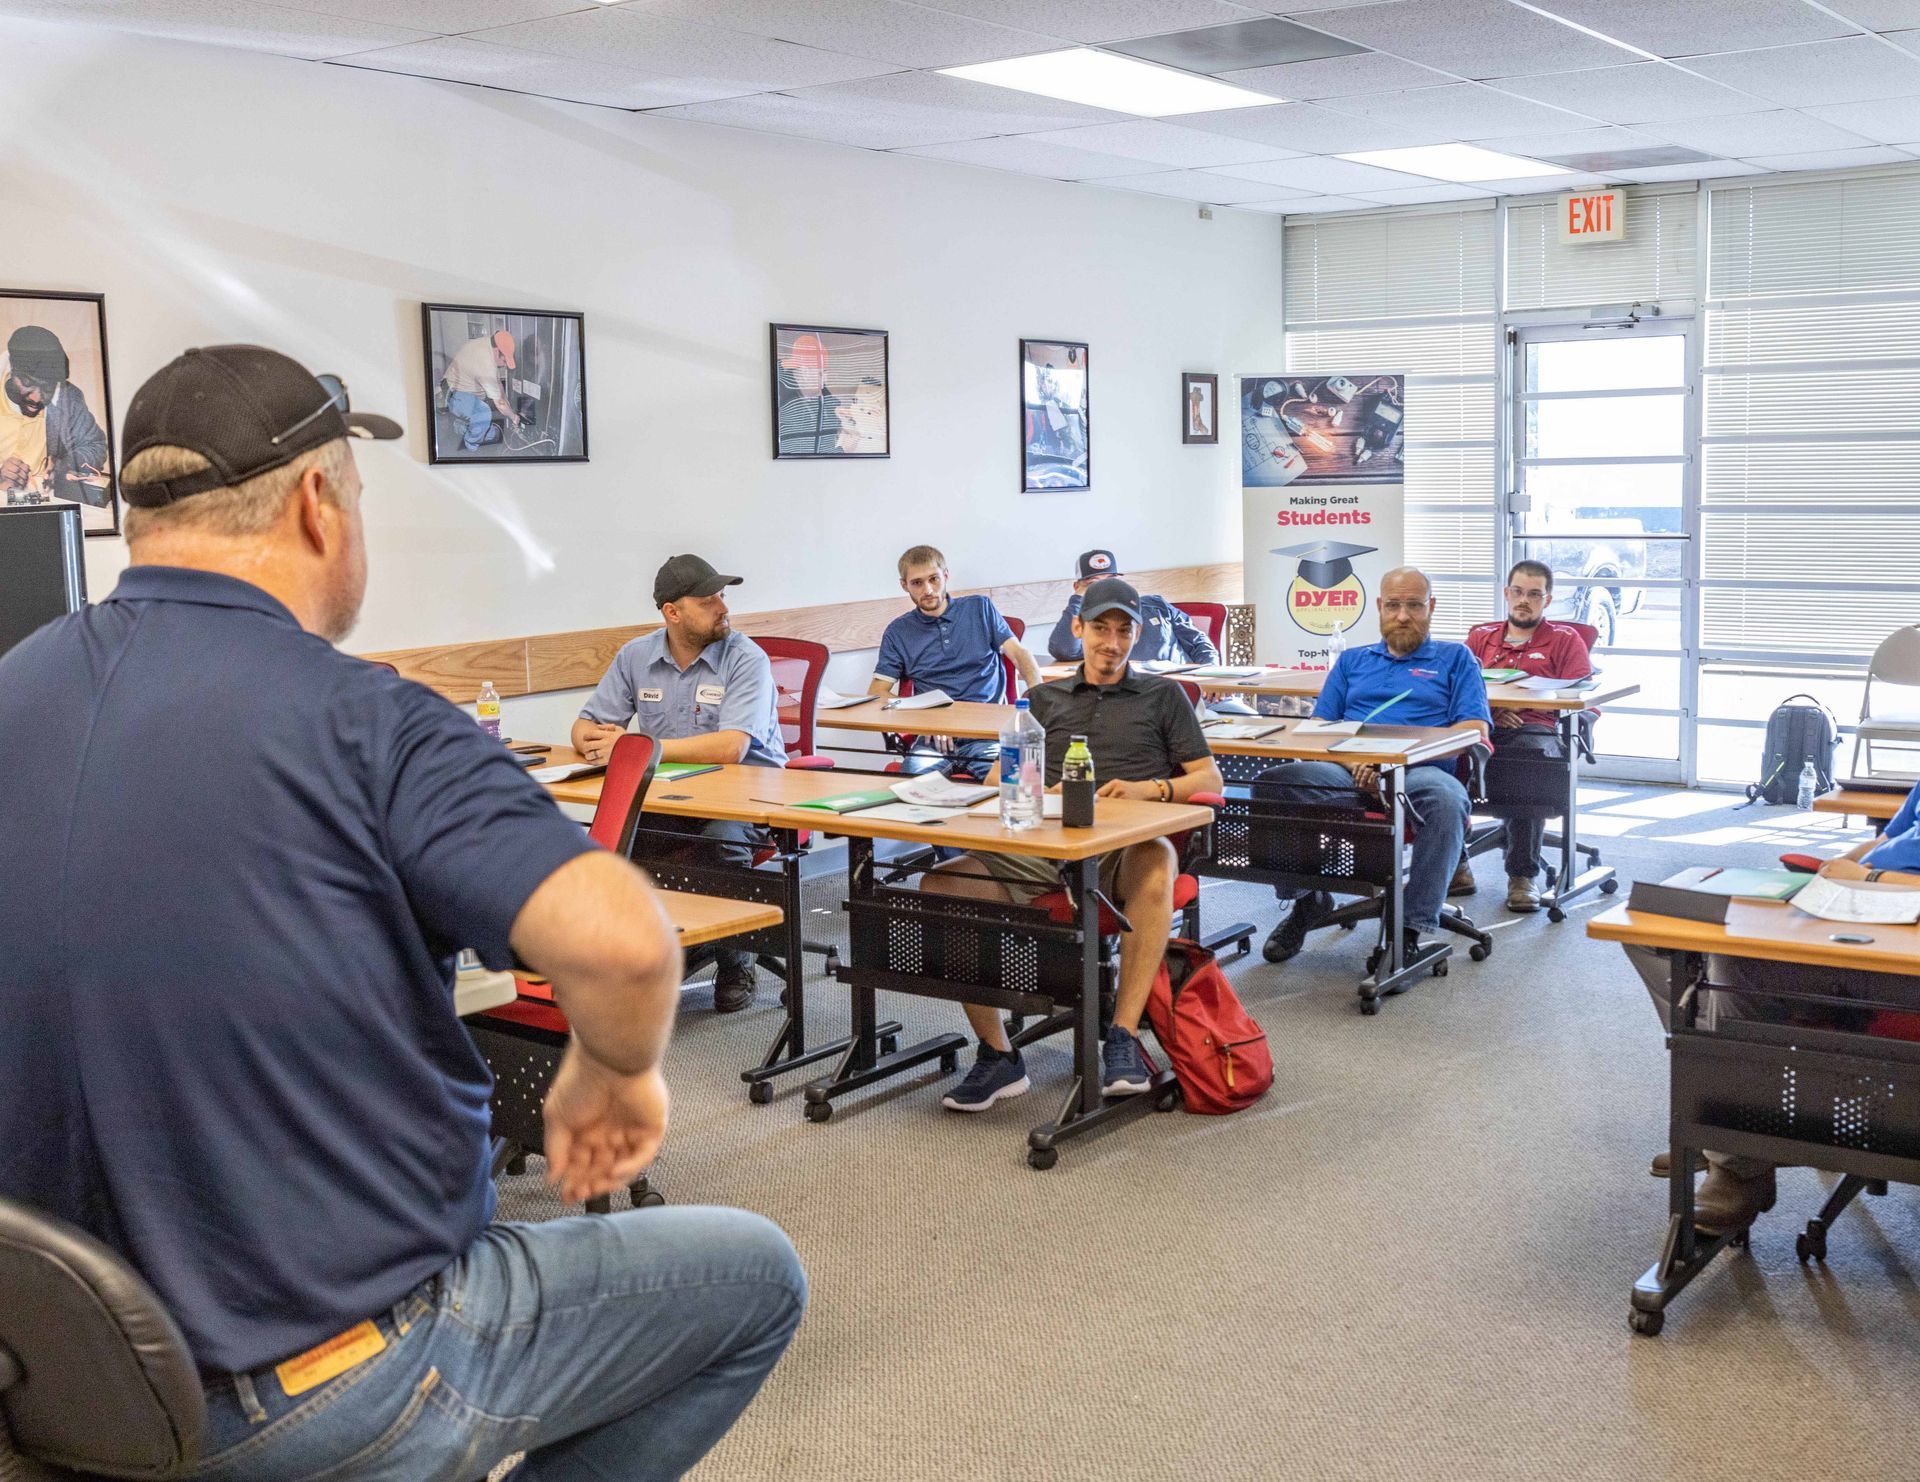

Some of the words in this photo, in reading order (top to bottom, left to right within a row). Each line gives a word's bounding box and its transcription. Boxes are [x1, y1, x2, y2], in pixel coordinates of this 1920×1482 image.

[1569, 195, 1614, 234] EXIT
[1289, 496, 1327, 506] Making
[1329, 496, 1359, 504] Great
[1277, 509, 1372, 526] Students
[1295, 590, 1358, 607] DYER
